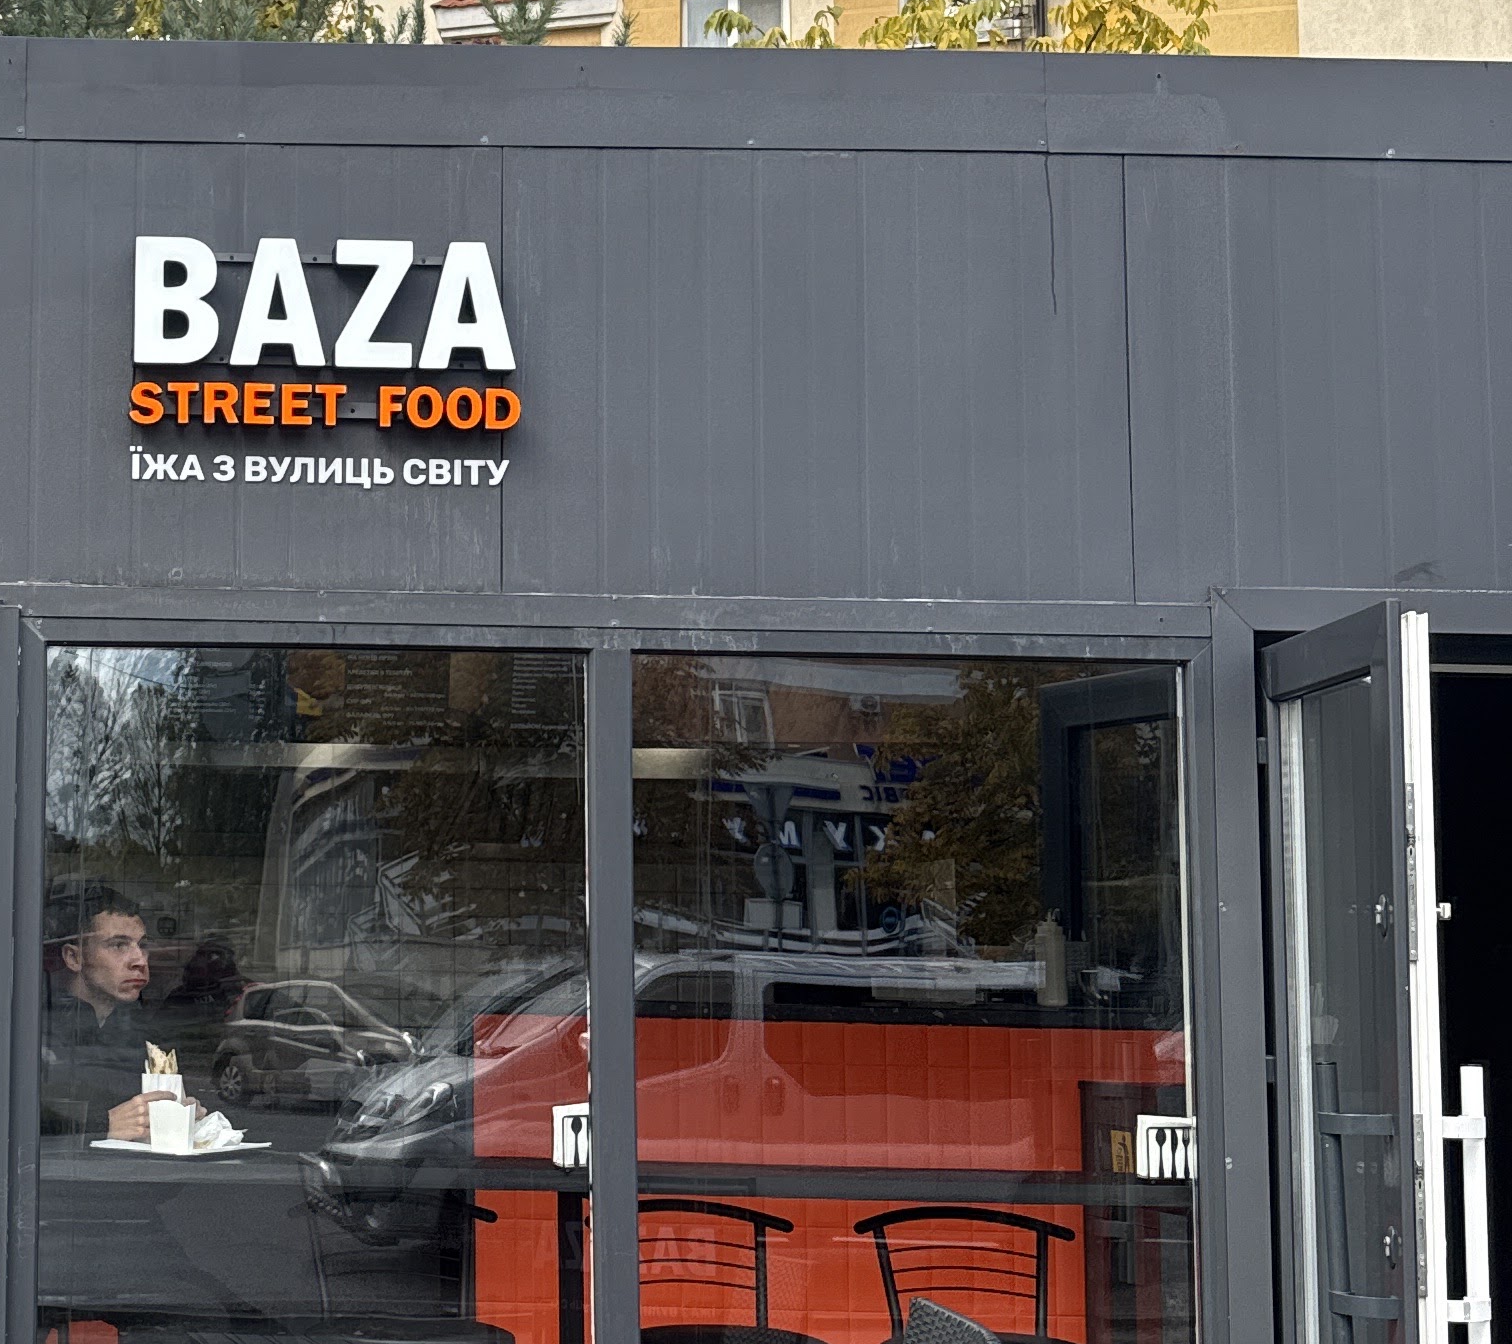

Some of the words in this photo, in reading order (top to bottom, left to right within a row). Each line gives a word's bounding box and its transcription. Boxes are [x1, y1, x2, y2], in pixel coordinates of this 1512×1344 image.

[133, 235, 517, 370] BAZA
[128, 381, 347, 427] STREET
[378, 385, 522, 430] FOOD
[128, 445, 206, 481] ЇЖА
[212, 454, 236, 482] З
[244, 456, 395, 489] ВУЛИЦЬ
[402, 458, 511, 486] СВІТУ
